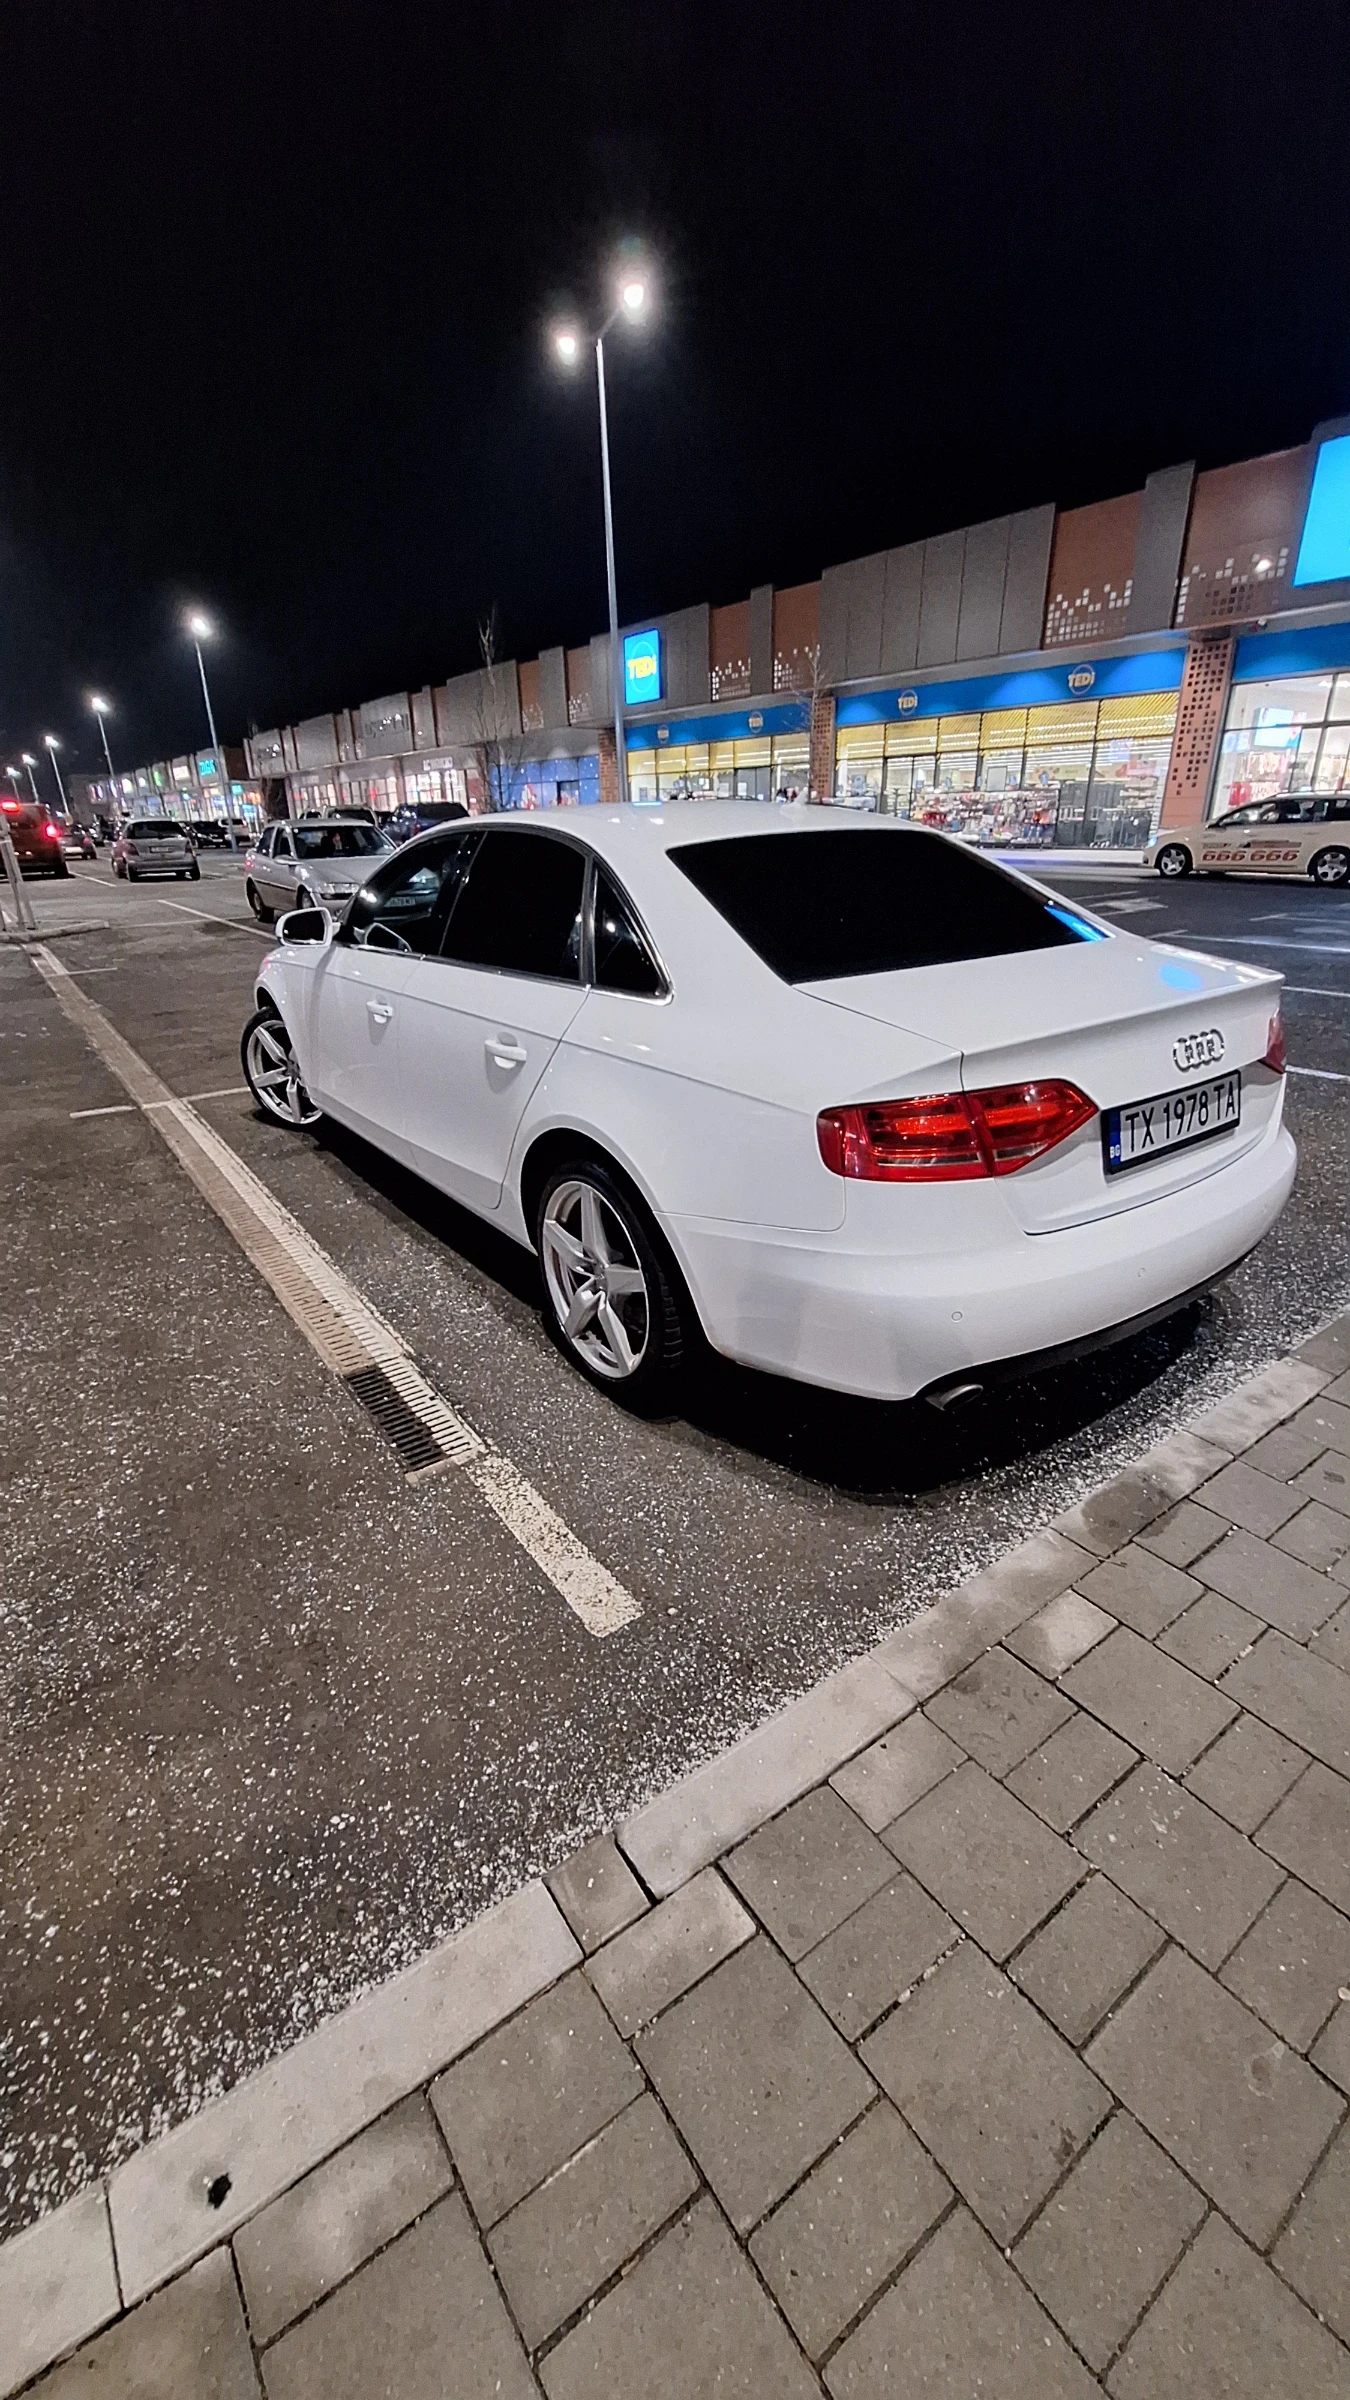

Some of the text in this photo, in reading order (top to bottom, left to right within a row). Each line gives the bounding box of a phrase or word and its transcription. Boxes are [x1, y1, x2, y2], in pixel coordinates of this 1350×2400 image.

[627, 654, 656, 680] TEDi
[1068, 672, 1094, 687] TEDi
[898, 695, 918, 709] TEDi
[1202, 850, 1299, 861] 666 666
[1125, 1081, 1236, 1152] TX 1978 TA
[1110, 1144, 1121, 1159] BG
